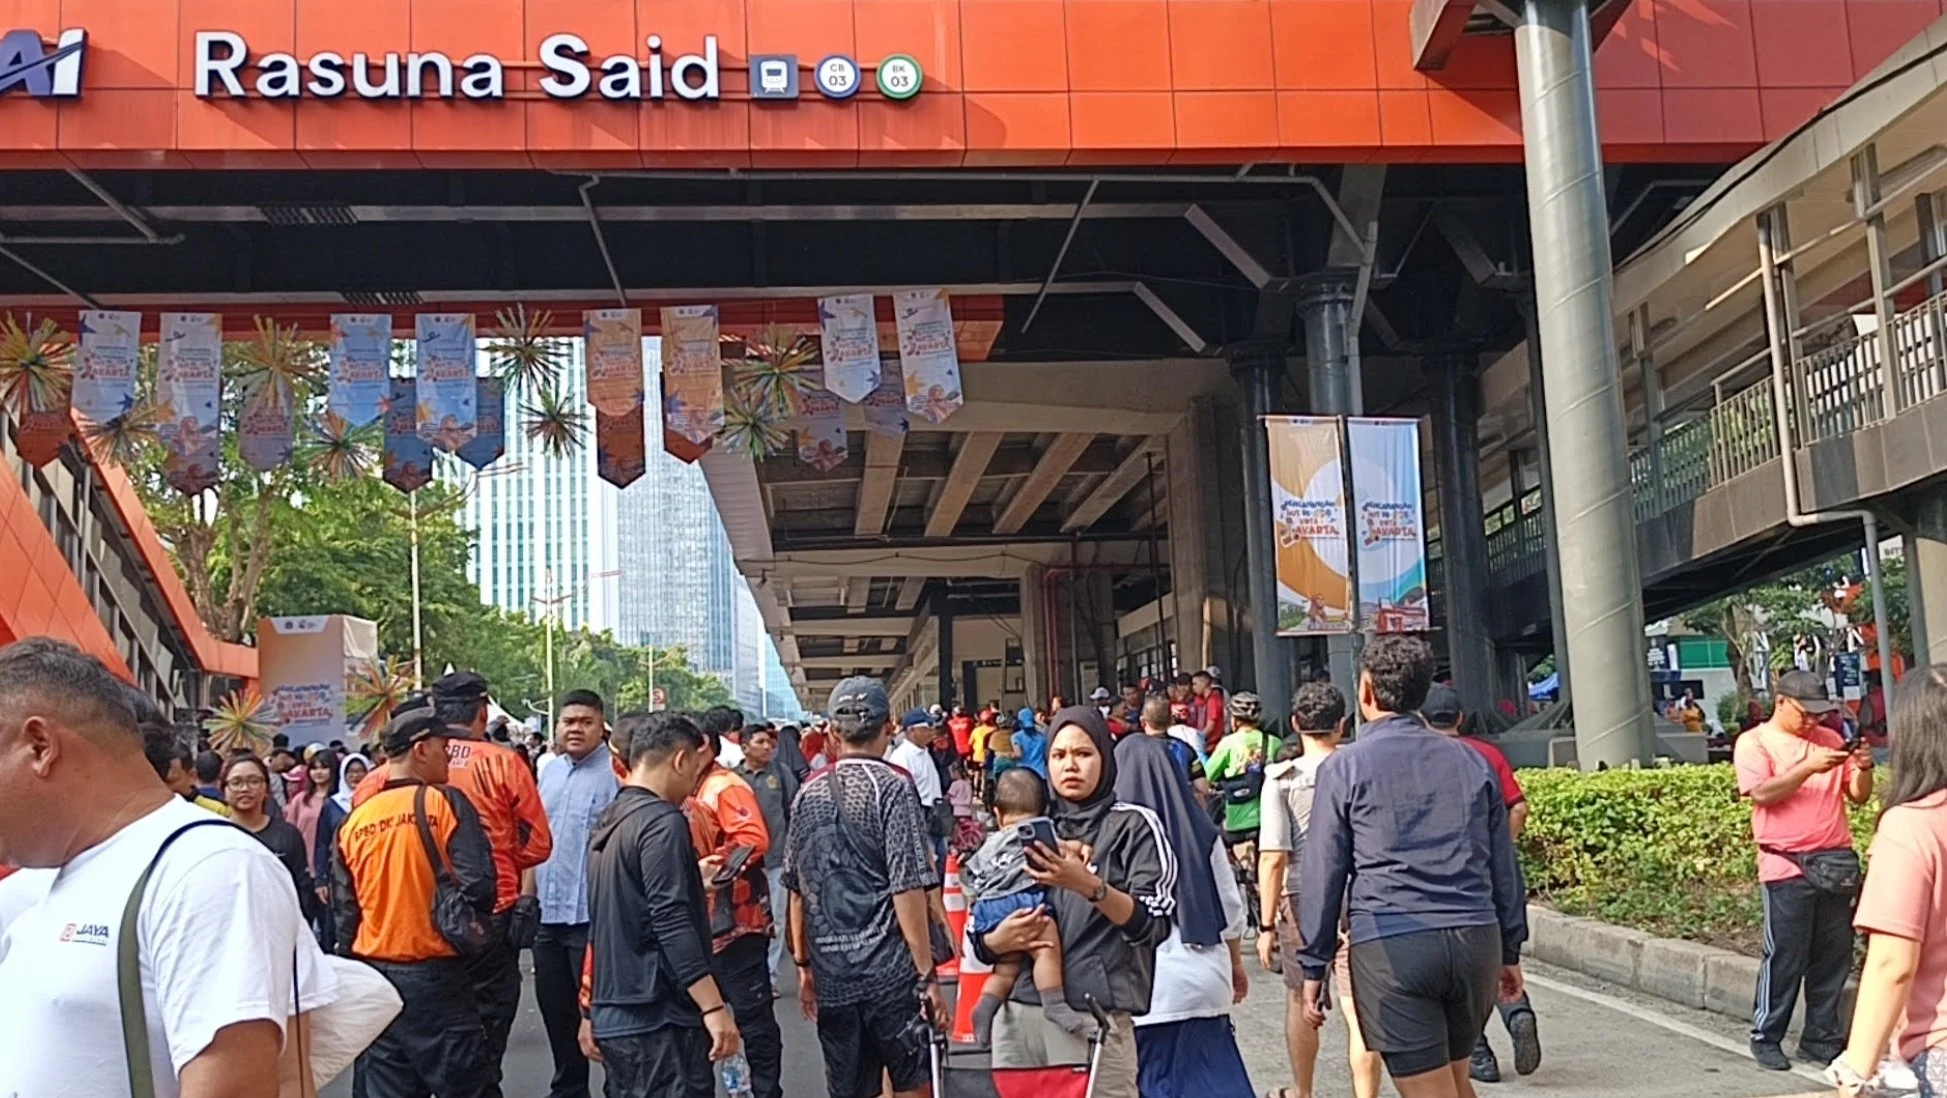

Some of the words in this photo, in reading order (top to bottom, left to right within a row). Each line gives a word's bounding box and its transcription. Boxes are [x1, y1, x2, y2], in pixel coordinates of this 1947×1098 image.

[195, 31, 503, 97] Rasuna
[539, 33, 720, 99] Said
[830, 63, 845, 72] CB
[828, 75, 847, 86] 03
[890, 76, 909, 87] 03
[395, 812, 439, 828] JAKTA
[76, 923, 109, 938] JAYA
